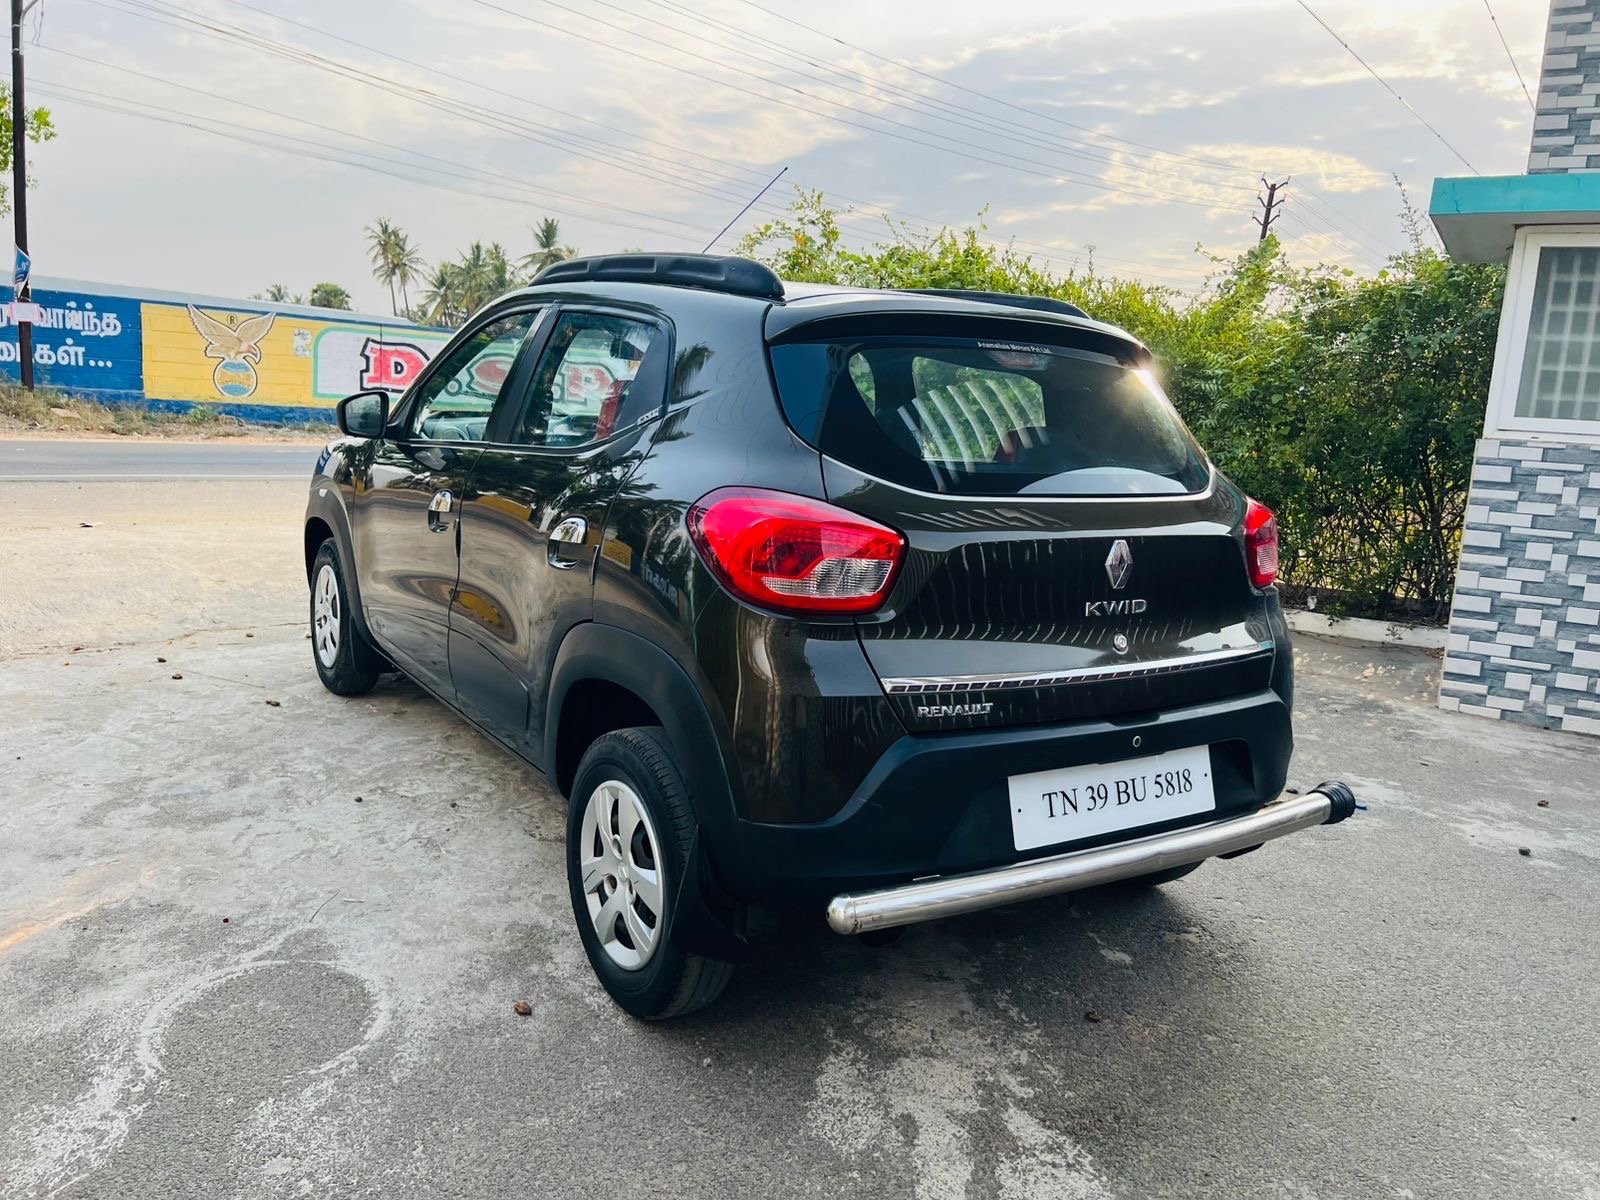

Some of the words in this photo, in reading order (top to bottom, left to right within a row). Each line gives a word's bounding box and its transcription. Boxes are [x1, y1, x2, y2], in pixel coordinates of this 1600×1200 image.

[1085, 599, 1148, 617] KWID
[917, 702, 993, 718] RENAULT
[1042, 788, 1079, 818] TN
[1085, 783, 1109, 811] 39
[1114, 776, 1148, 806] BU
[1154, 768, 1193, 799] 5818
